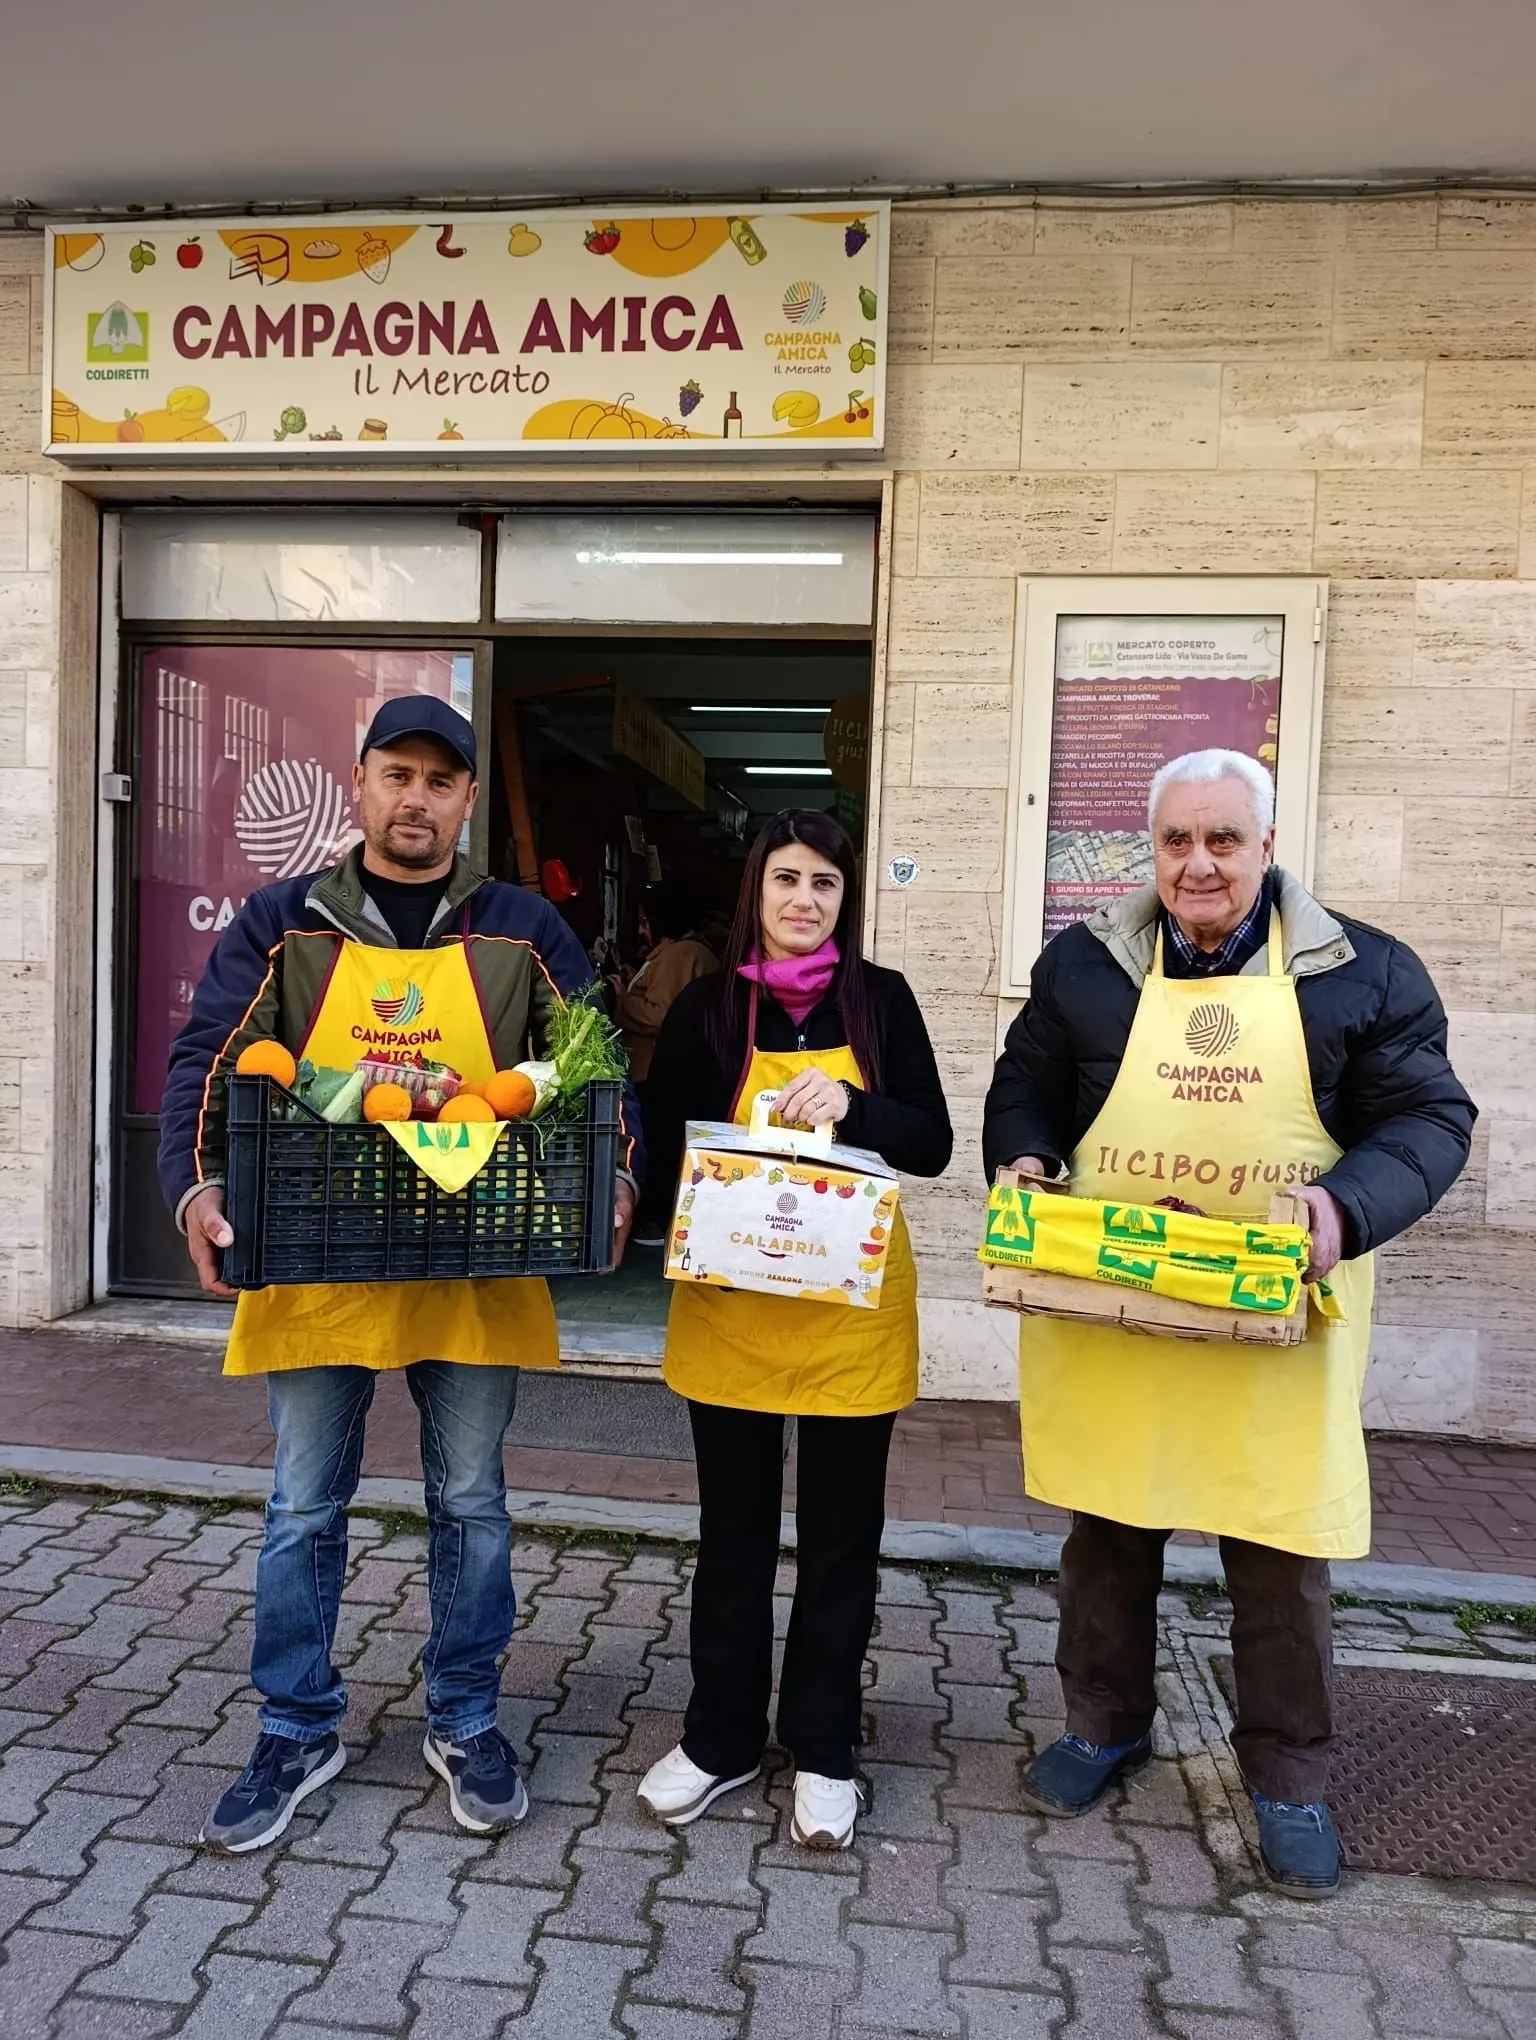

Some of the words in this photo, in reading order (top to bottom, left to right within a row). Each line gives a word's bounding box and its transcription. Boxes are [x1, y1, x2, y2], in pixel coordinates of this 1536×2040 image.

[172, 299, 500, 360] CAMPAGNA
[518, 294, 745, 354] AMICA
[764, 331, 842, 346] CAMPAGNA
[776, 346, 829, 361] AMICA
[85, 368, 150, 381] COLDIRETTI
[773, 365, 783, 374] Il
[785, 364, 832, 374] Mercato
[353, 364, 380, 395] Il
[392, 364, 550, 395] Mercato
[1117, 641, 1166, 649] MERCATO
[1168, 641, 1216, 649] COPERTO
[1155, 652, 1172, 660] Lido
[1178, 652, 1190, 660] Via
[1191, 652, 1213, 660] Vasco
[1213, 652, 1225, 660] De
[1226, 652, 1248, 661] Gama
[1056, 694, 1097, 702] CAMPAGNA
[1127, 752, 1136, 761] (DI
[1136, 752, 1165, 760] PECORA,
[1128, 761, 1156, 769] BUFALA)
[1094, 800, 1140, 808] CONFETTURE,
[188, 896, 247, 932] CA
[351, 1025, 442, 1046] CAMPAGNA
[1156, 1062, 1264, 1084] CAMPAGNA
[760, 1094, 777, 1102] CAM
[1171, 1083, 1244, 1103] AMICA
[1097, 1146, 1119, 1173] Il
[1126, 1149, 1220, 1184] CIBO
[1228, 1158, 1320, 1196] giusto
[765, 1214, 803, 1227] CAMPAGNA
[769, 1223, 796, 1232] AMICA
[730, 1231, 828, 1257] CALABRIA
[766, 1273, 803, 1284] PERSONE
[1096, 1268, 1153, 1291] COLDIRETTI
